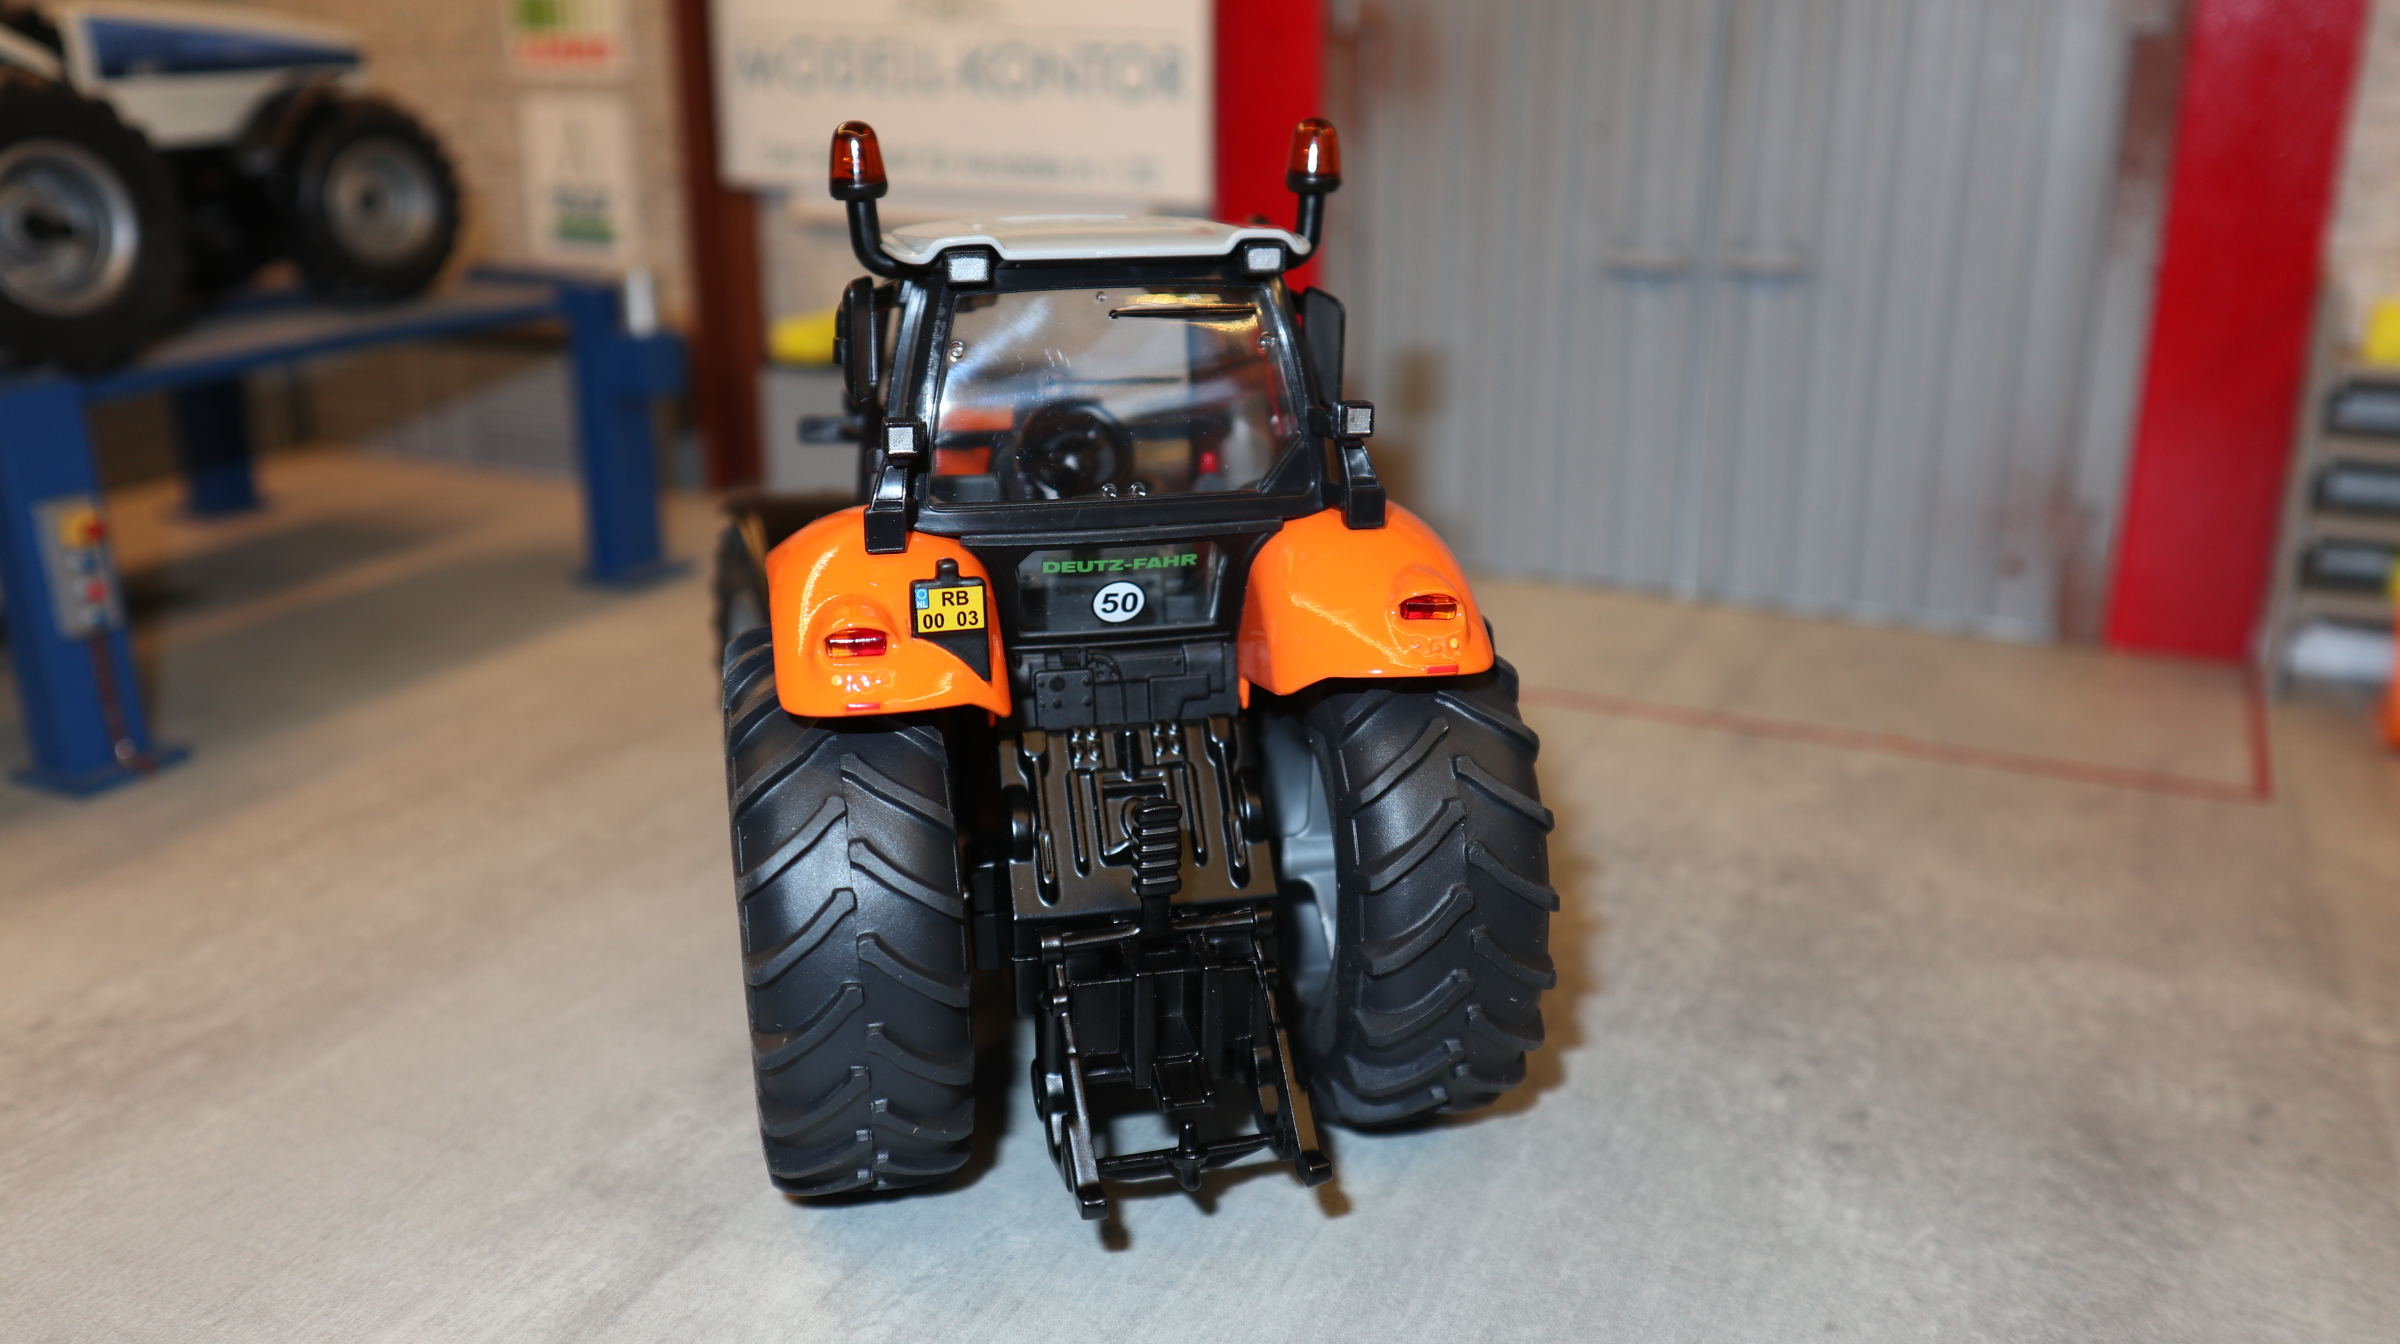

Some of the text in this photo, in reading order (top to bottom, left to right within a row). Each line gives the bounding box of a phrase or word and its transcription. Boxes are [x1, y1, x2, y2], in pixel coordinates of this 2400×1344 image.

[1042, 553, 1198, 574] DEUTZ-FAHR
[916, 600, 928, 609] NL
[941, 590, 969, 607] RB
[1100, 592, 1138, 614] 50
[923, 610, 979, 629] 00 03
